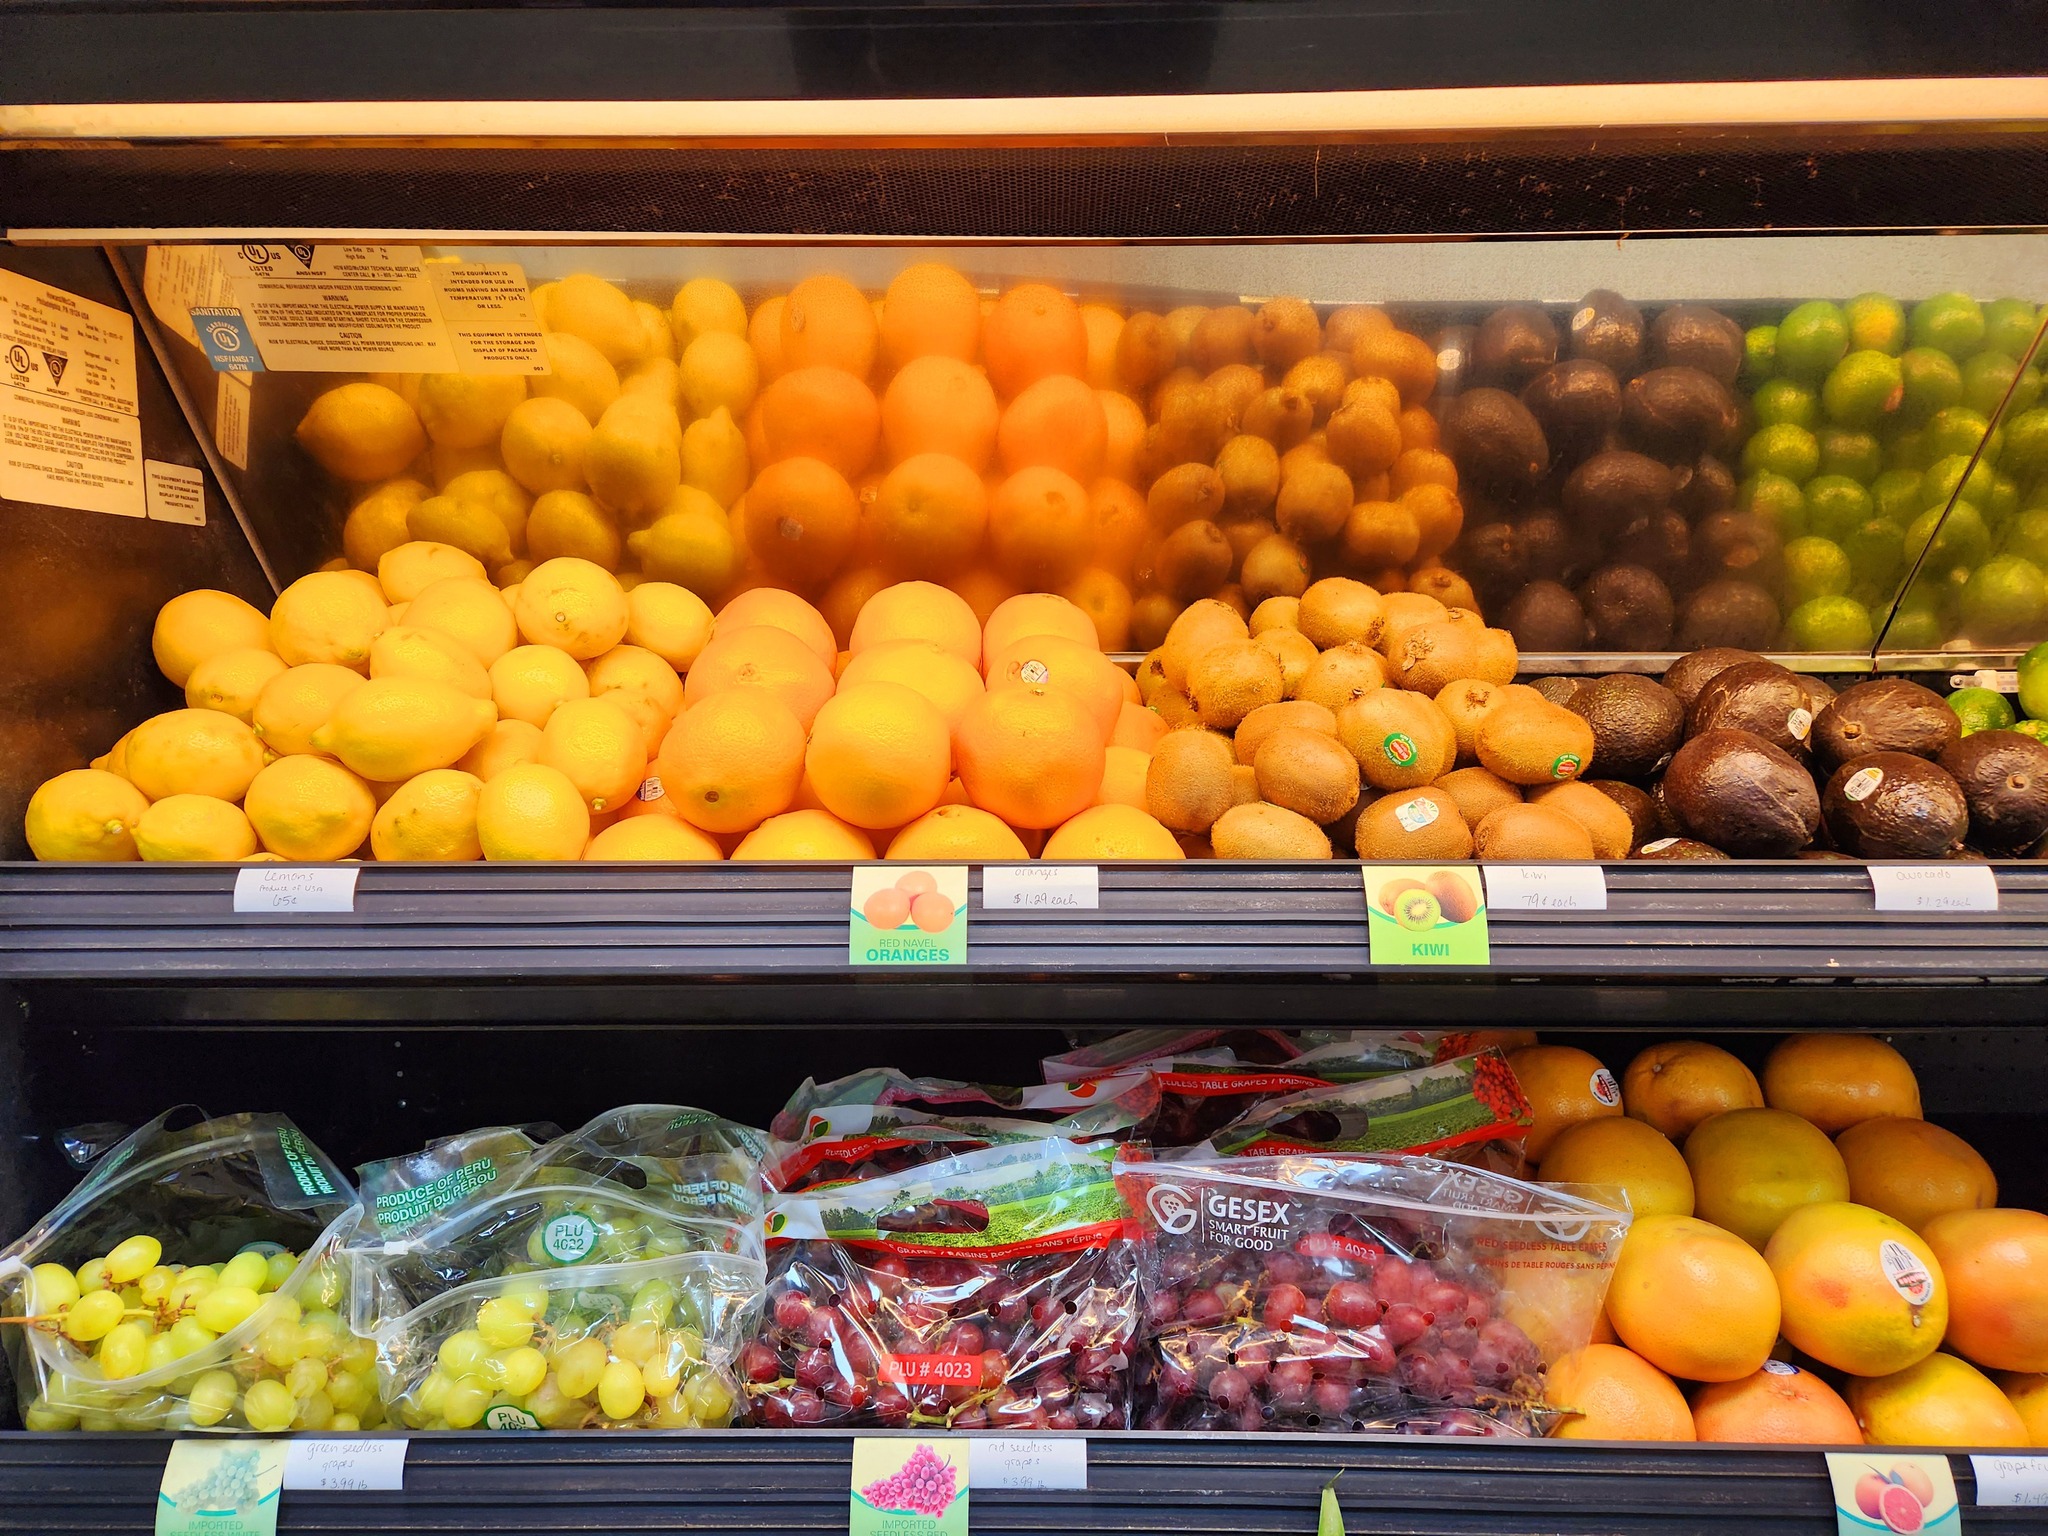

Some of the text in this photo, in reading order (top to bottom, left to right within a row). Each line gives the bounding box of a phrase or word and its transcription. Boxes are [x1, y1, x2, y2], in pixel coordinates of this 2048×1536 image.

[270, 252, 281, 260] US
[190, 307, 241, 317] SANITATION
[206, 321, 239, 334] CLASSIFIED
[217, 333, 236, 347] UL
[1050, 893, 1079, 906] each
[879, 938, 937, 949] RED NAVEL
[1411, 943, 1450, 956] KIWI
[865, 948, 950, 962] ORANGES
[1200, 1079, 1229, 1090] TABLE
[1247, 1147, 1276, 1157] TABLE
[276, 1127, 320, 1196] PRODUCE OF PERU
[307, 1166, 337, 1194] PRODUIT
[376, 1183, 436, 1209] PRODUCE
[437, 1173, 455, 1192] OF
[378, 1168, 497, 1225] PRODUIT DU PÉROU
[1208, 1195, 1291, 1226] GESEX
[554, 1224, 584, 1237] PLU
[1208, 1219, 1290, 1241] SMART FRUIT
[553, 1238, 584, 1250] 4022
[1209, 1230, 1274, 1252] FOR GOOD
[1476, 1237, 1608, 1252] RED SEEDLESS TABLE GRAPES
[947, 1250, 988, 1260] RAISINS
[1299, 1238, 1378, 1261] PLU # 4023
[1510, 1261, 1521, 1269] DE
[1523, 1261, 1544, 1270] TABLE
[1545, 1261, 1575, 1270] ROUGES
[1576, 1262, 1595, 1270] SANS
[888, 1361, 973, 1379] PLU # 4023
[497, 1412, 527, 1425] PLU
[188, 1520, 244, 1531] IMPORTED
[882, 1519, 936, 1529] IMPORTED
